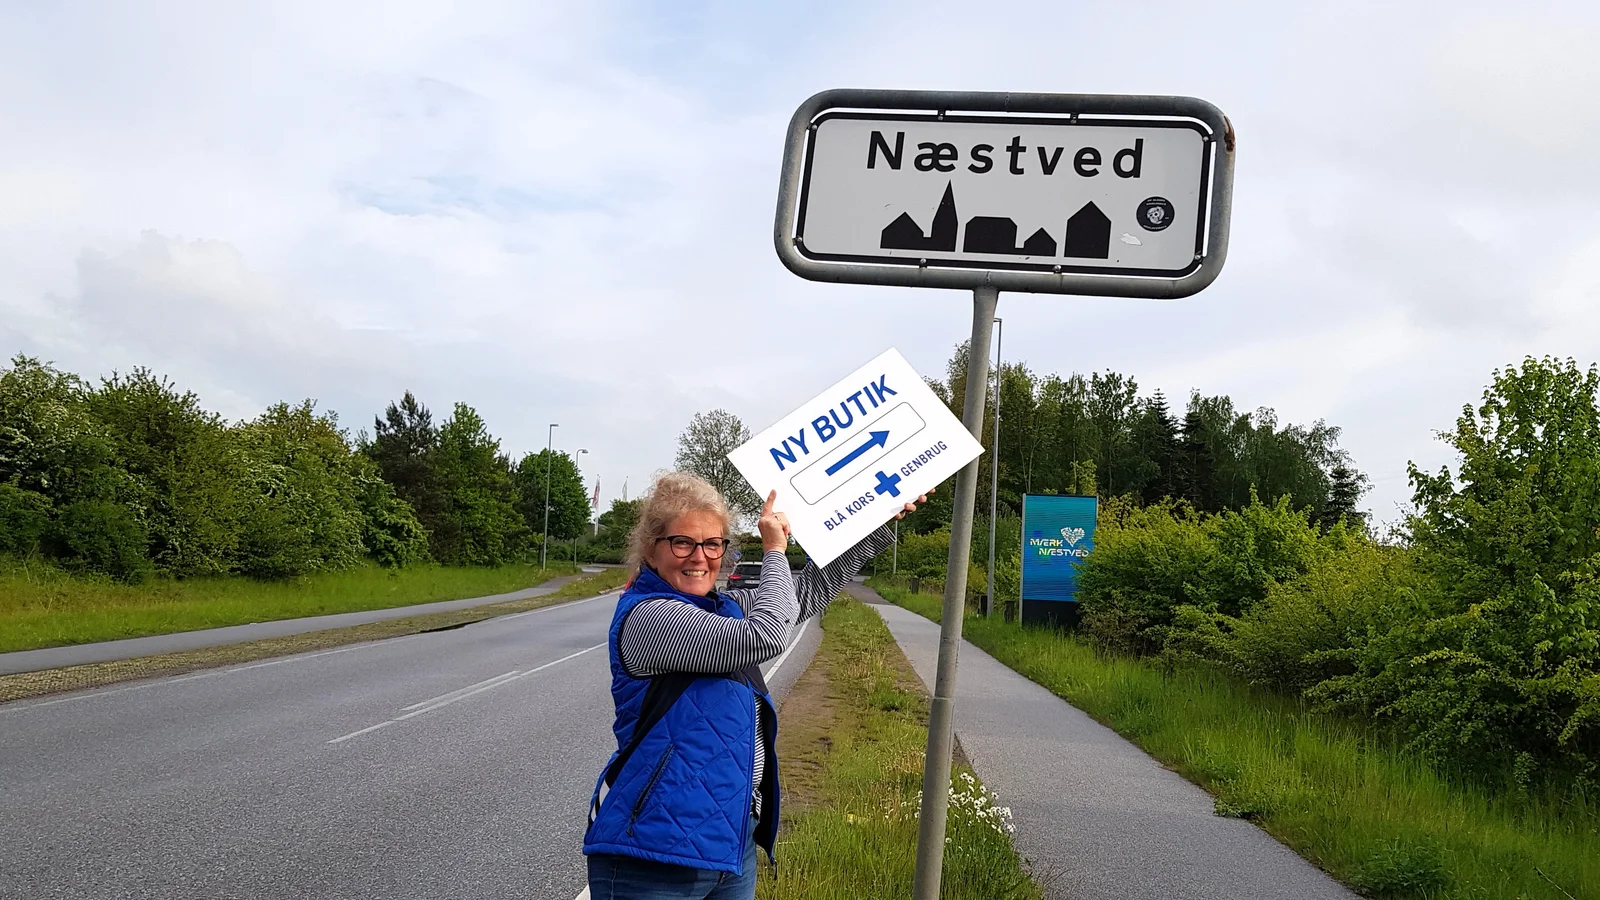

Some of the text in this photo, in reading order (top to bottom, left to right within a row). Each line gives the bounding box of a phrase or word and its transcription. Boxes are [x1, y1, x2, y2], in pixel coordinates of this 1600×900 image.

[867, 131, 1144, 179] Næstved
[769, 373, 898, 471] NY BUTIK
[823, 440, 948, 531] BLÅ KORS GENBRUG
[1029, 538, 1063, 547] MÆRK
